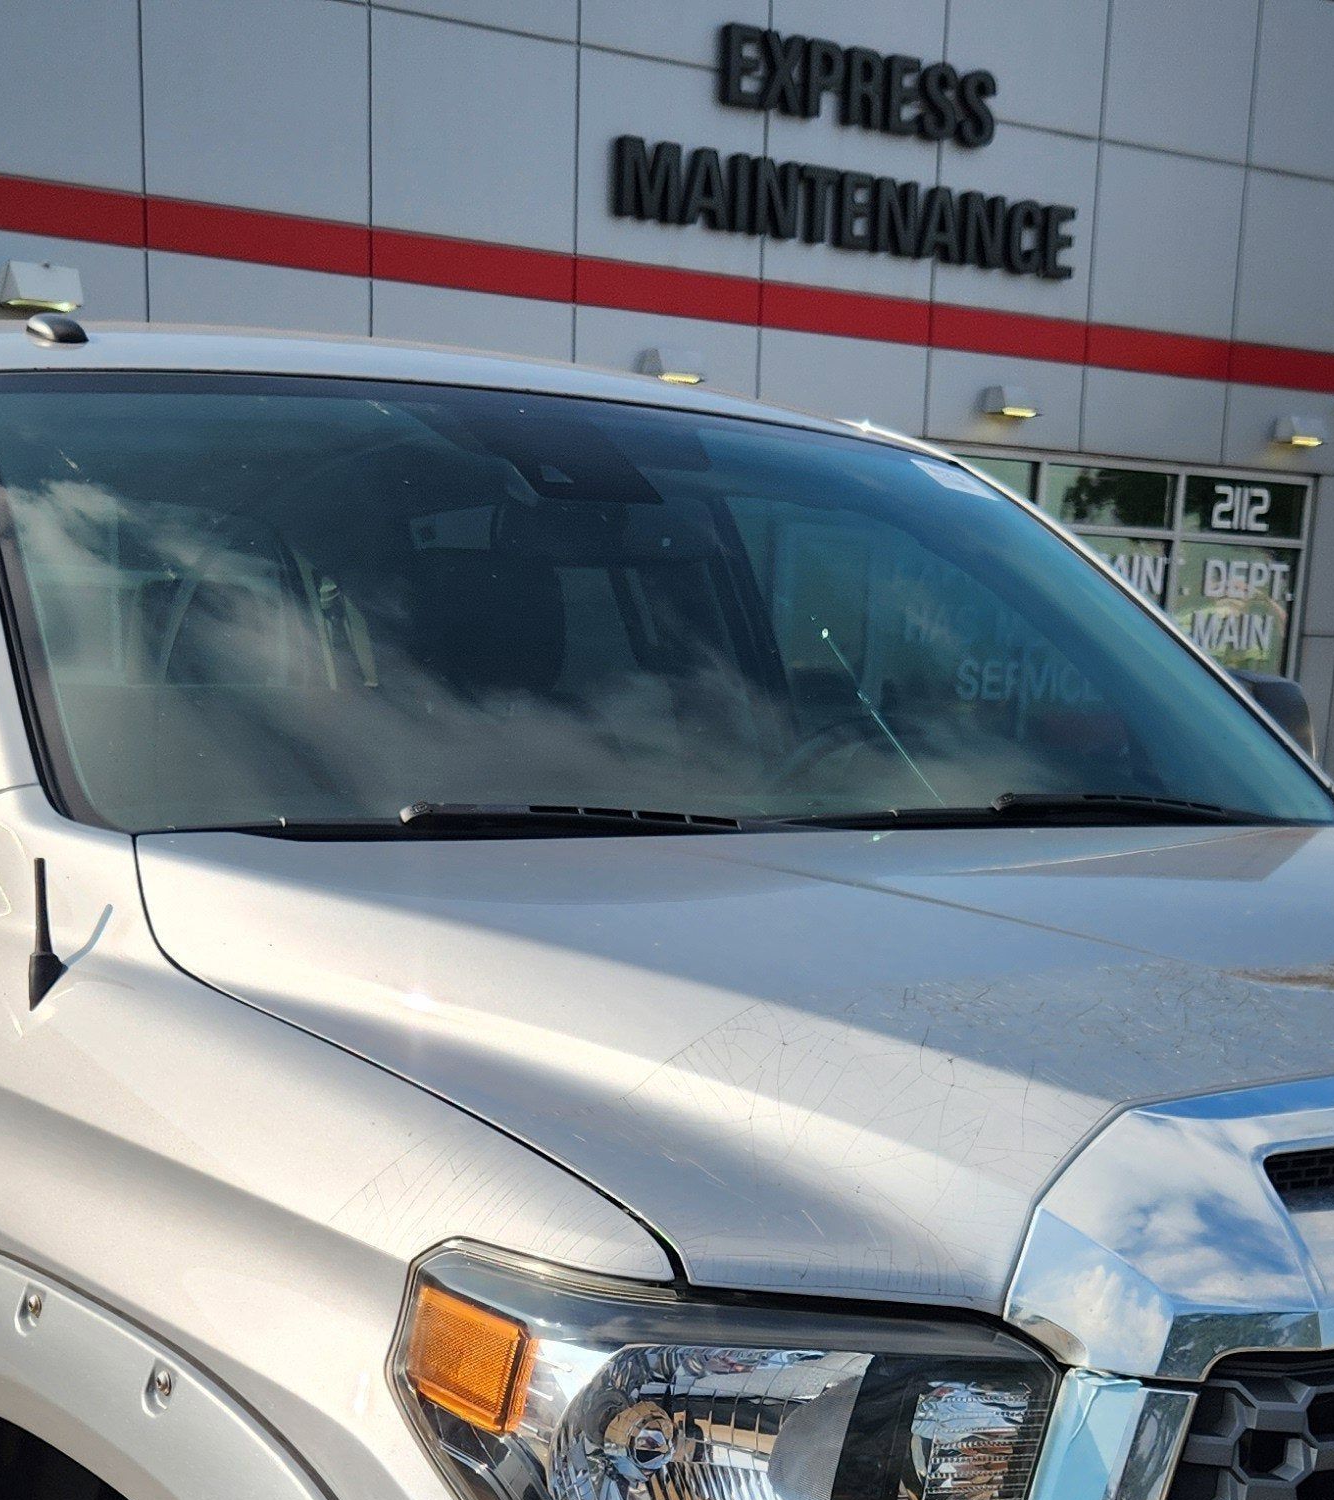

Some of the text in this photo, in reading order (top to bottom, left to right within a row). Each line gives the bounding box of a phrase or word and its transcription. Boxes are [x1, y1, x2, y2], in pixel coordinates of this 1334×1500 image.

[716, 22, 997, 148] EXPRESS
[609, 134, 1076, 280] MAINTENANCE
[1211, 485, 1271, 532] 2112
[1203, 558, 1293, 601] DEPT.
[1191, 609, 1275, 652] MAIN
